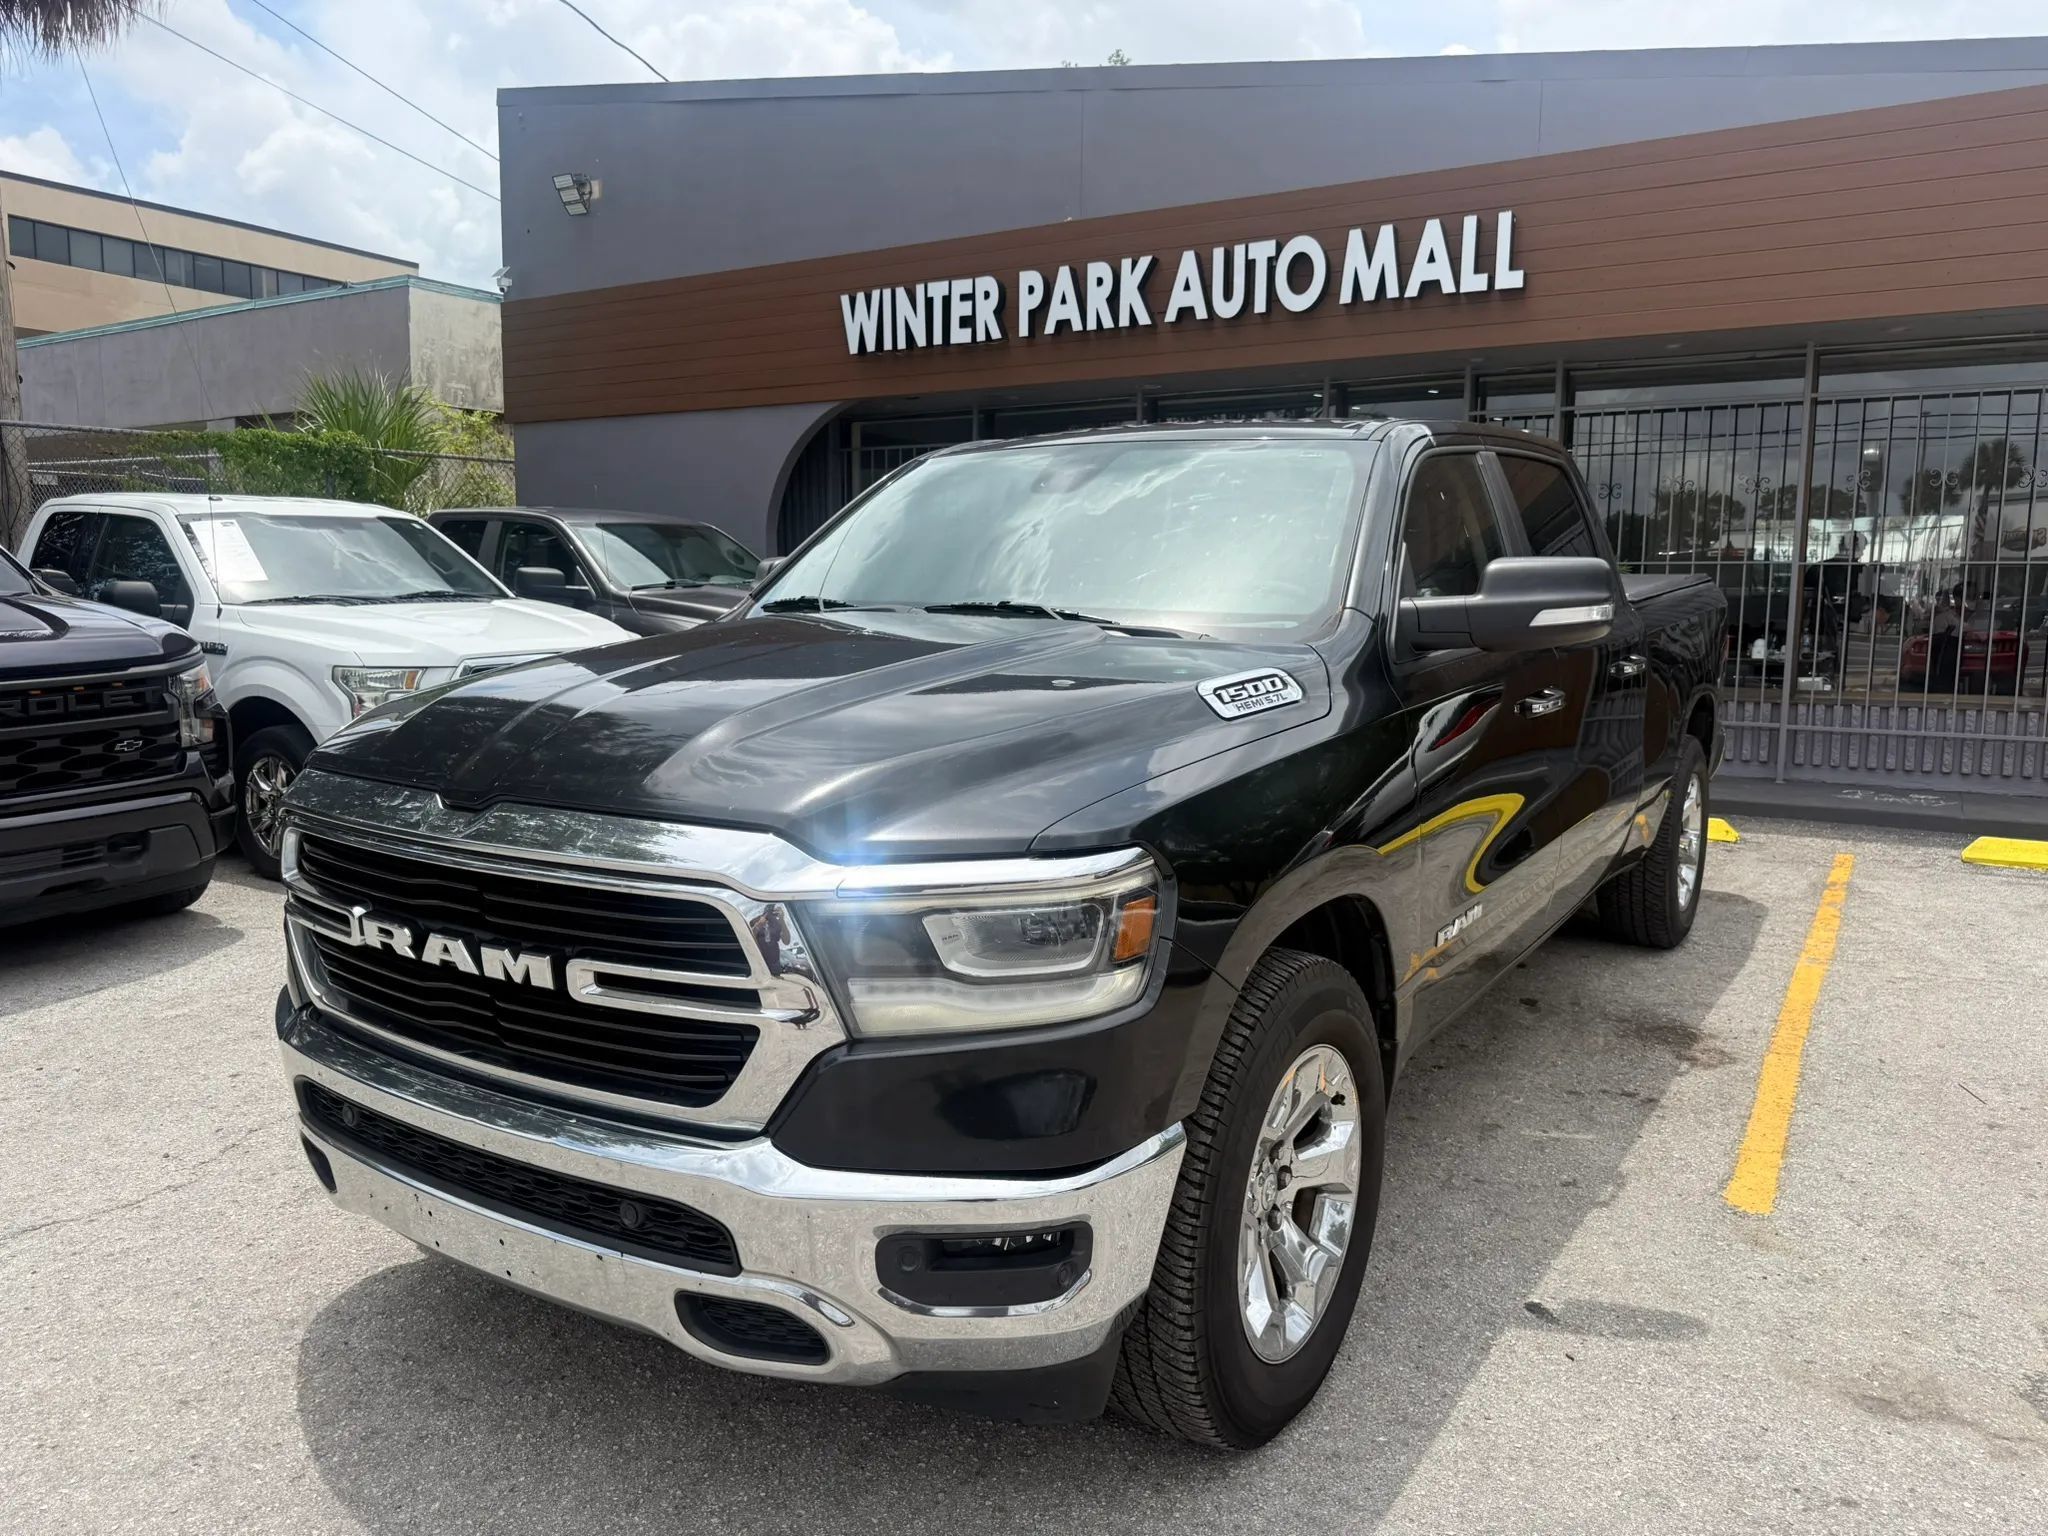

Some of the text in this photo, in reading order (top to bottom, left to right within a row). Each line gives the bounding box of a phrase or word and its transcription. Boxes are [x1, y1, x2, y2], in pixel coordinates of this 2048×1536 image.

[840, 210, 1526, 356] WINTER PARK AUTO MALL
[1215, 677, 1284, 703] 1500
[1234, 692, 1288, 712] HEMI 5.7L
[1435, 903, 1483, 947] RAM
[361, 914, 555, 990] RAM
